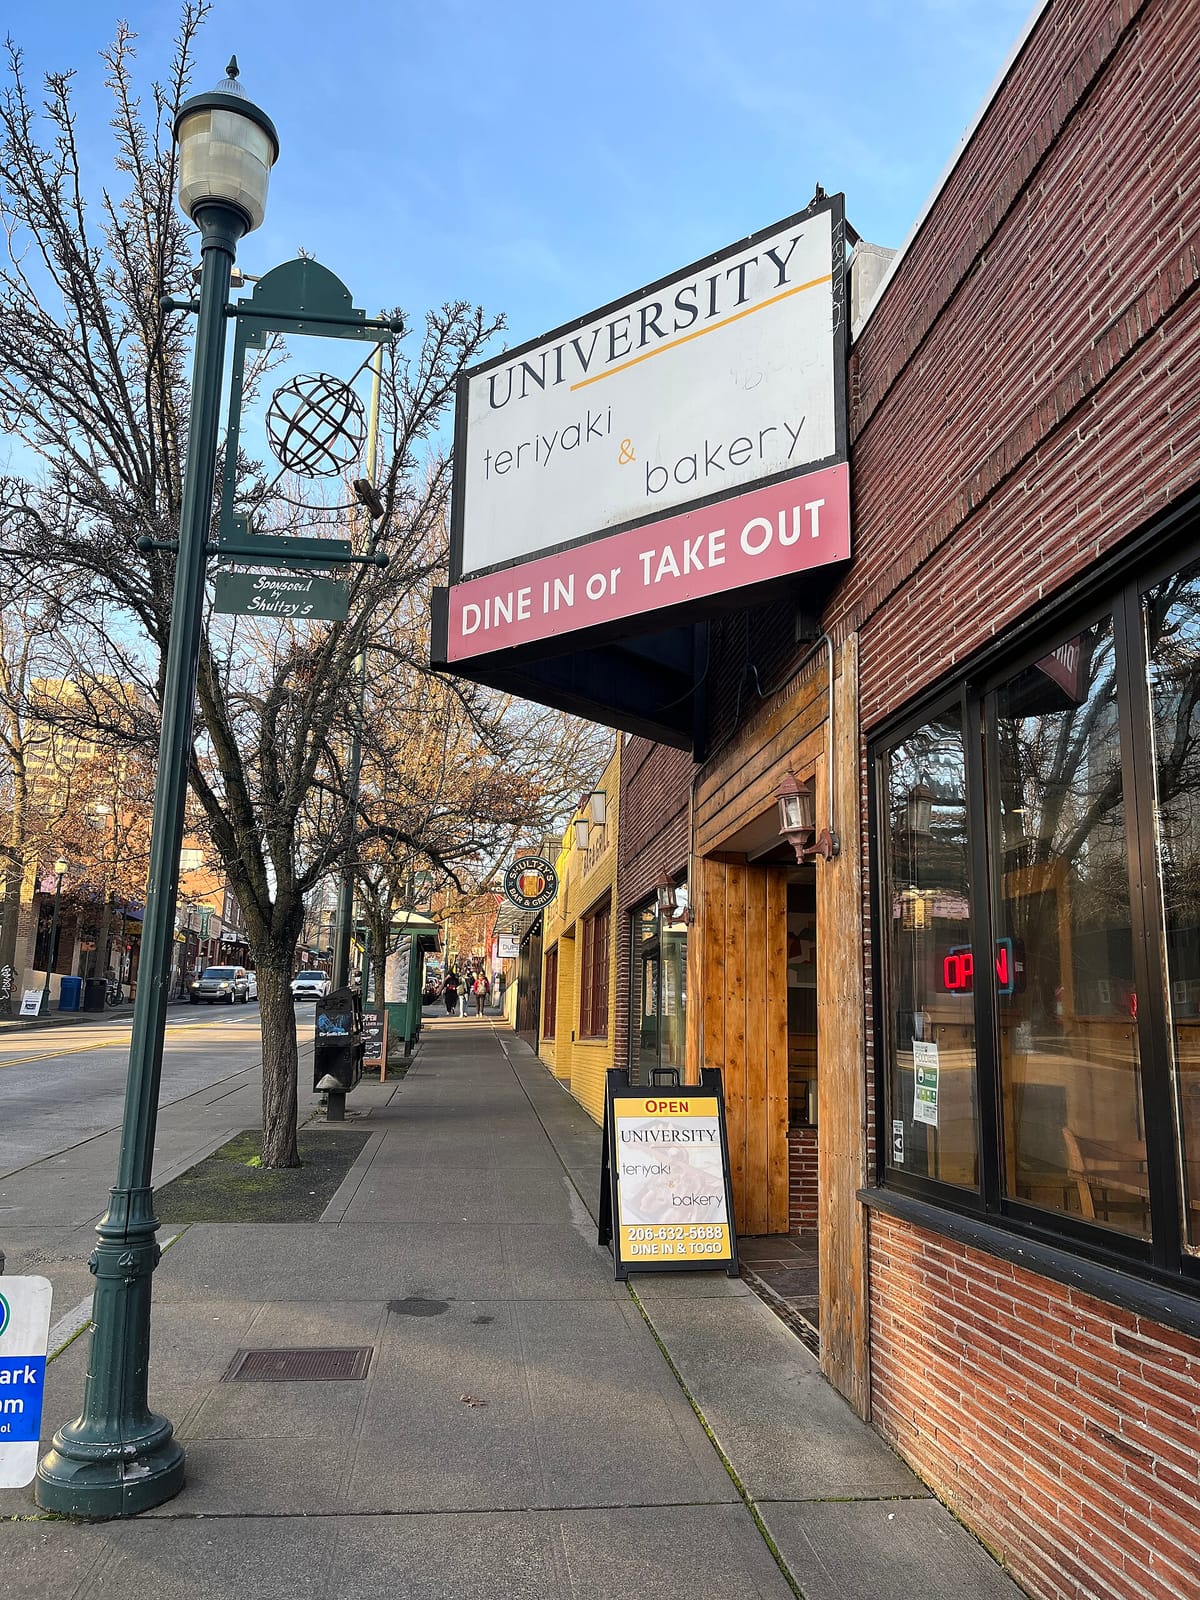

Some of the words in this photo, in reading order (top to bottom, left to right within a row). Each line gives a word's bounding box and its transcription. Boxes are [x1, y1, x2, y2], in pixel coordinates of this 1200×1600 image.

[486, 233, 805, 410] UNIVERSITY
[484, 405, 612, 481] teriyaki
[617, 438, 636, 466] &
[645, 415, 806, 497] bakery
[461, 586, 532, 637] DINE
[542, 573, 575, 613] IN
[585, 565, 622, 601] or
[638, 529, 726, 586] TAKE
[739, 498, 826, 556] OUT
[270, 590, 282, 600] by
[246, 596, 314, 616] Shultzy's
[510, 860, 554, 881] SHULTZY'S
[509, 888, 523, 903] BAR
[523, 899, 531, 907] &
[532, 889, 553, 906] GRILL
[943, 948, 1008, 989] OPN
[645, 1099, 689, 1114] OPEN
[621, 1129, 716, 1143] UNIVERSITY
[622, 1161, 671, 1177] teriyaki
[671, 1192, 724, 1208] bakery
[627, 1225, 724, 1242] 206-632-5688
[630, 1243, 659, 1256] DINE
[660, 1242, 674, 1255] IN
[676, 1242, 687, 1255] &
[688, 1241, 723, 1255] TOGO
